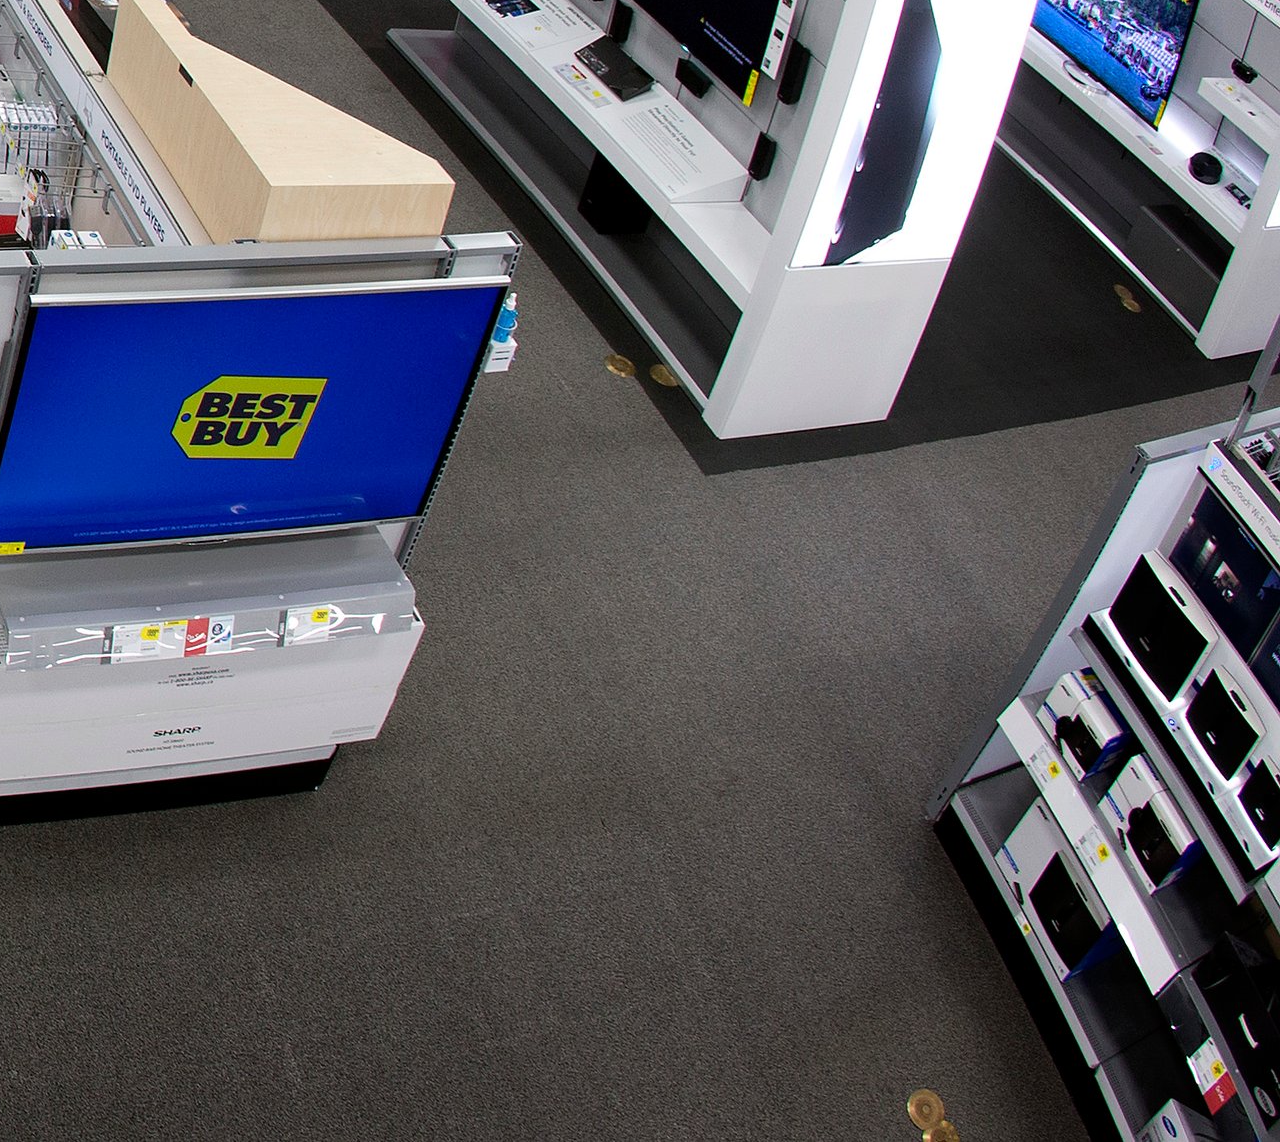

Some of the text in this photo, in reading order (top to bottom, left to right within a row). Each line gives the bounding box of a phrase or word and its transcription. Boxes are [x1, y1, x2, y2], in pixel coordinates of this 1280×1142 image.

[26, 12, 53, 56] RECORDERS
[100, 129, 166, 243] PORTABLE DVD PLAYERS
[194, 392, 318, 420] BEST
[188, 419, 300, 447] BUY
[1220, 469, 1251, 509] SoundTouch
[1252, 507, 1265, 528] Wi-Fi
[178, 668, 230, 677] www.sharpusa.com
[153, 726, 202, 738] SHARP
